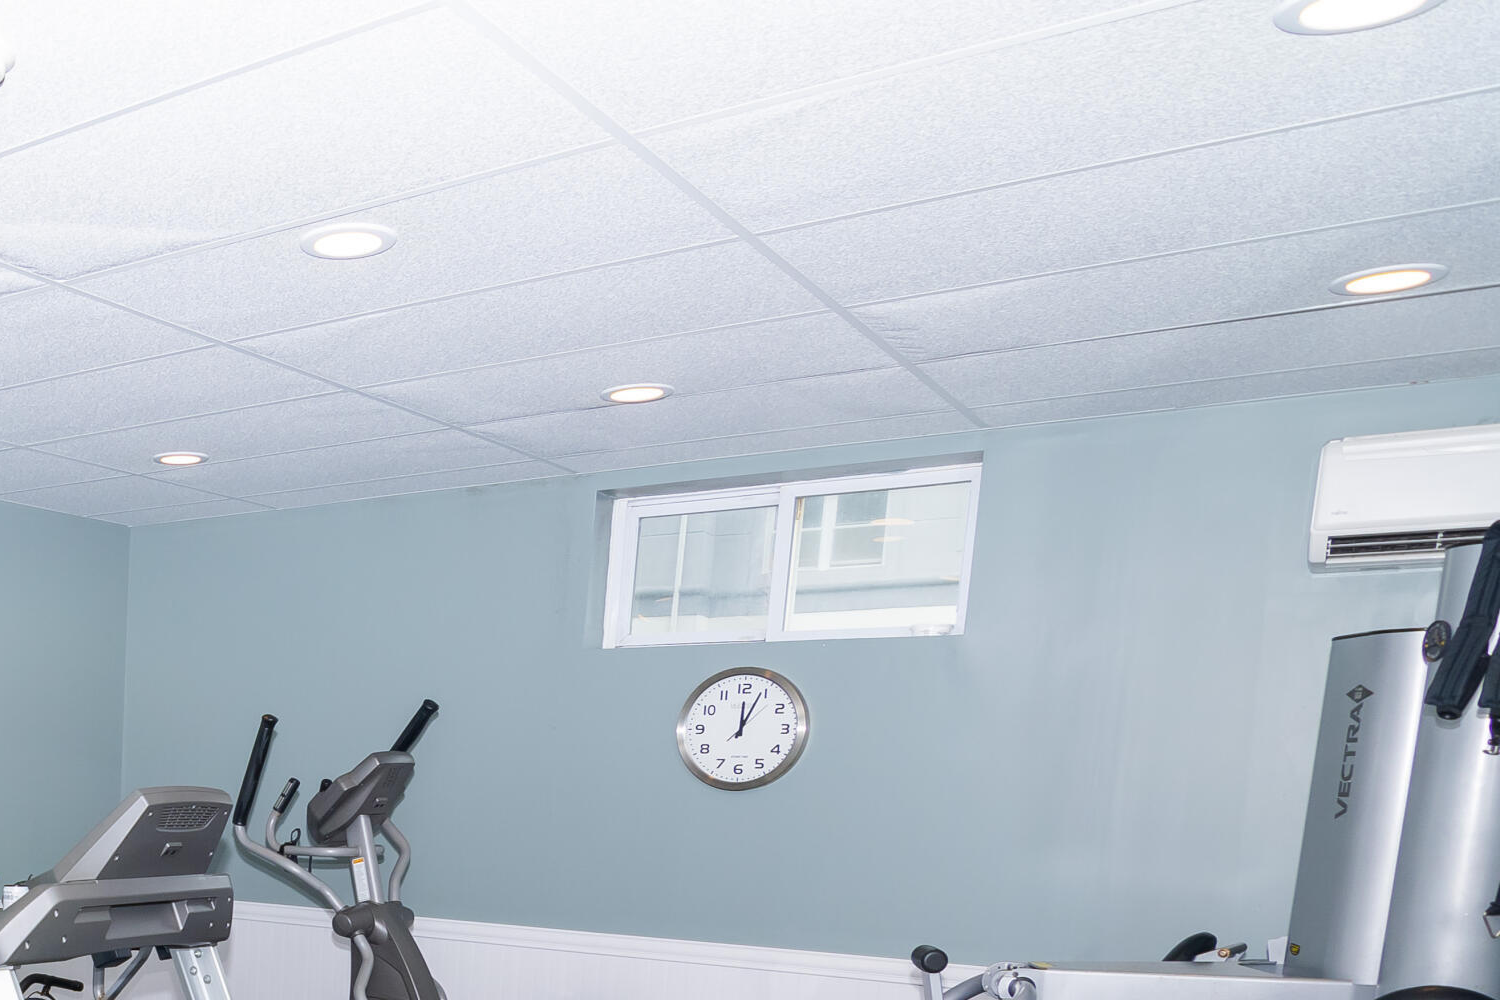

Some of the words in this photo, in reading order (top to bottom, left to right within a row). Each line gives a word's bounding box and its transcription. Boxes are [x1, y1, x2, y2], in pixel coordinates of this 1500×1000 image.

[737, 683, 753, 695] 12
[720, 690, 729, 701] 11
[703, 704, 716, 716] 10
[774, 703, 785, 715] 2
[695, 724, 705, 735] 9
[780, 723, 790, 735] 3
[699, 743, 710, 755] 8
[770, 743, 781, 755] 4
[716, 758, 726, 769] 7
[754, 758, 765, 770] 5
[1333, 702, 1366, 820] VECTRA
[733, 763, 744, 775] 6
